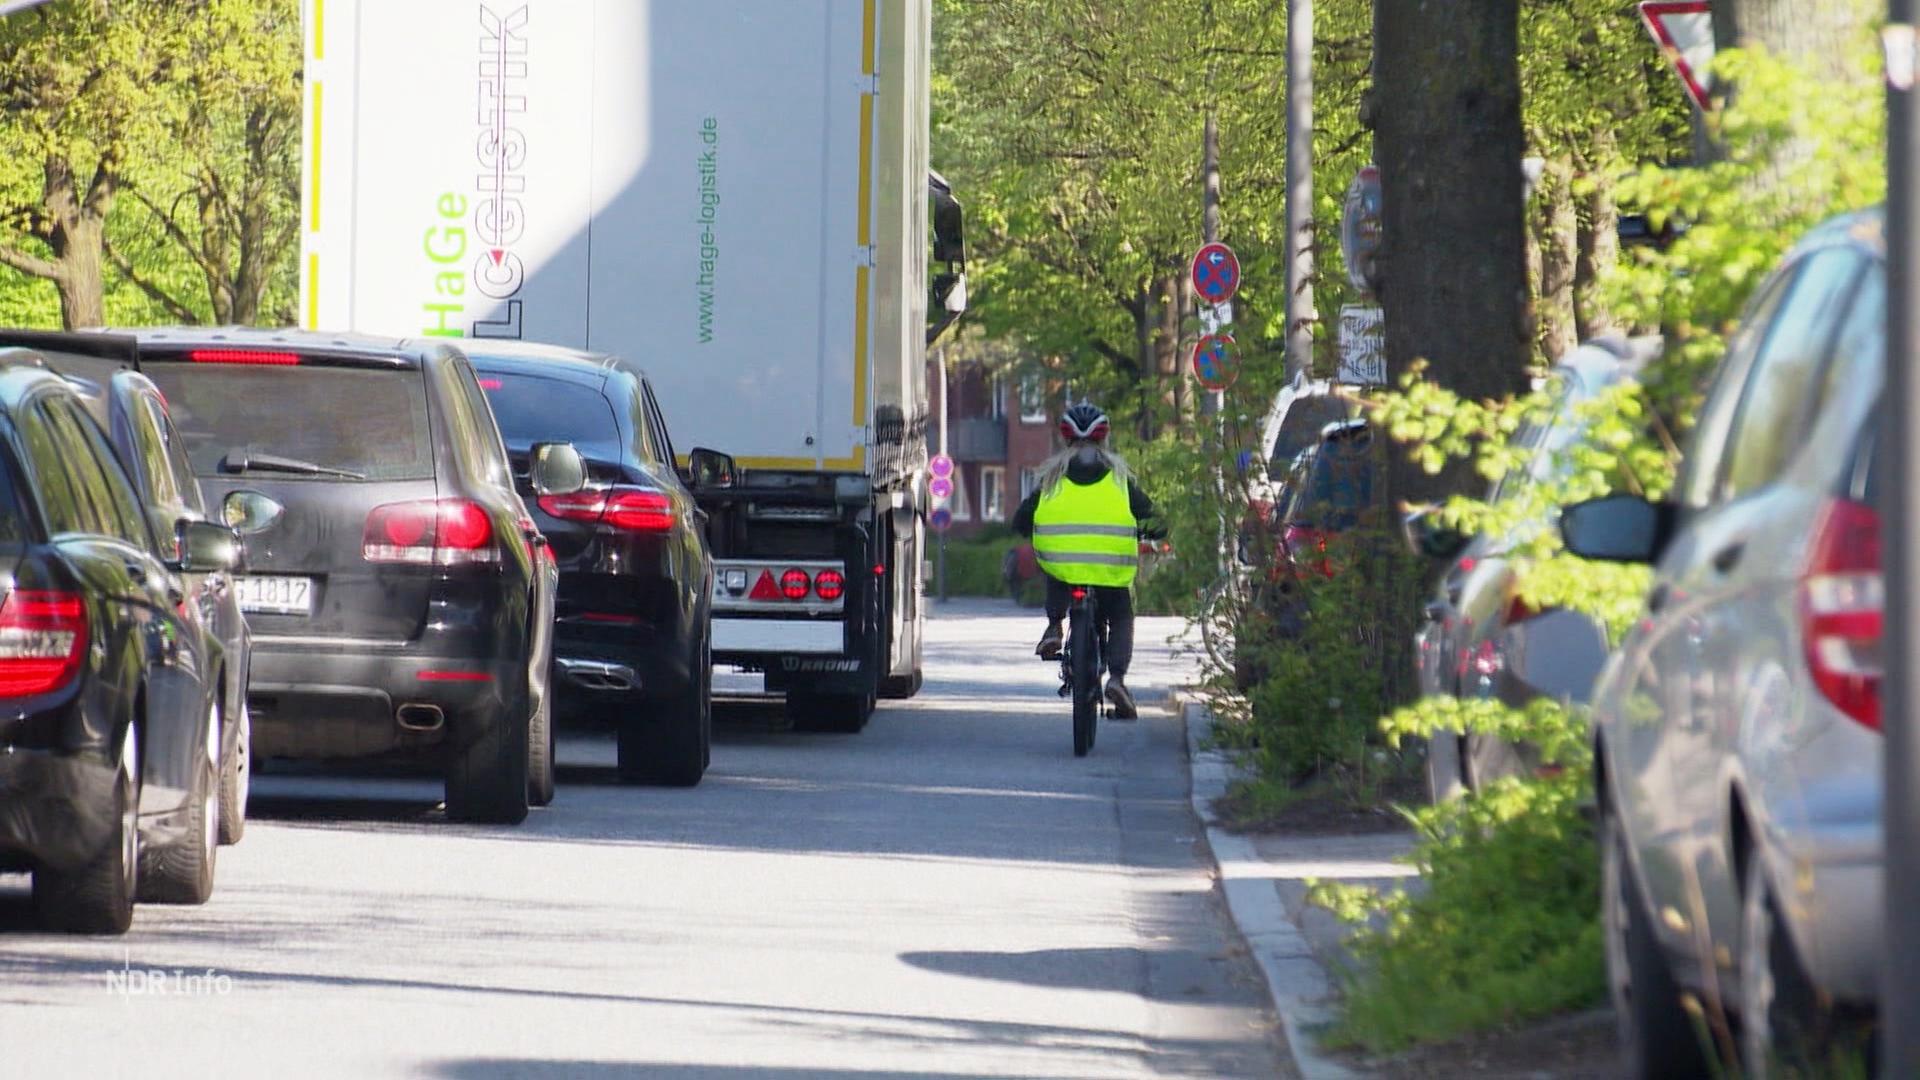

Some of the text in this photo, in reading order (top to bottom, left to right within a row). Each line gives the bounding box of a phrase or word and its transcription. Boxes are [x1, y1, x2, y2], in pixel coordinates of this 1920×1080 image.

[422, 191, 468, 338] HaGe
[696, 116, 720, 344] www.hage-logistik.de
[251, 578, 308, 605] 1817
[801, 659, 861, 672] KRONE
